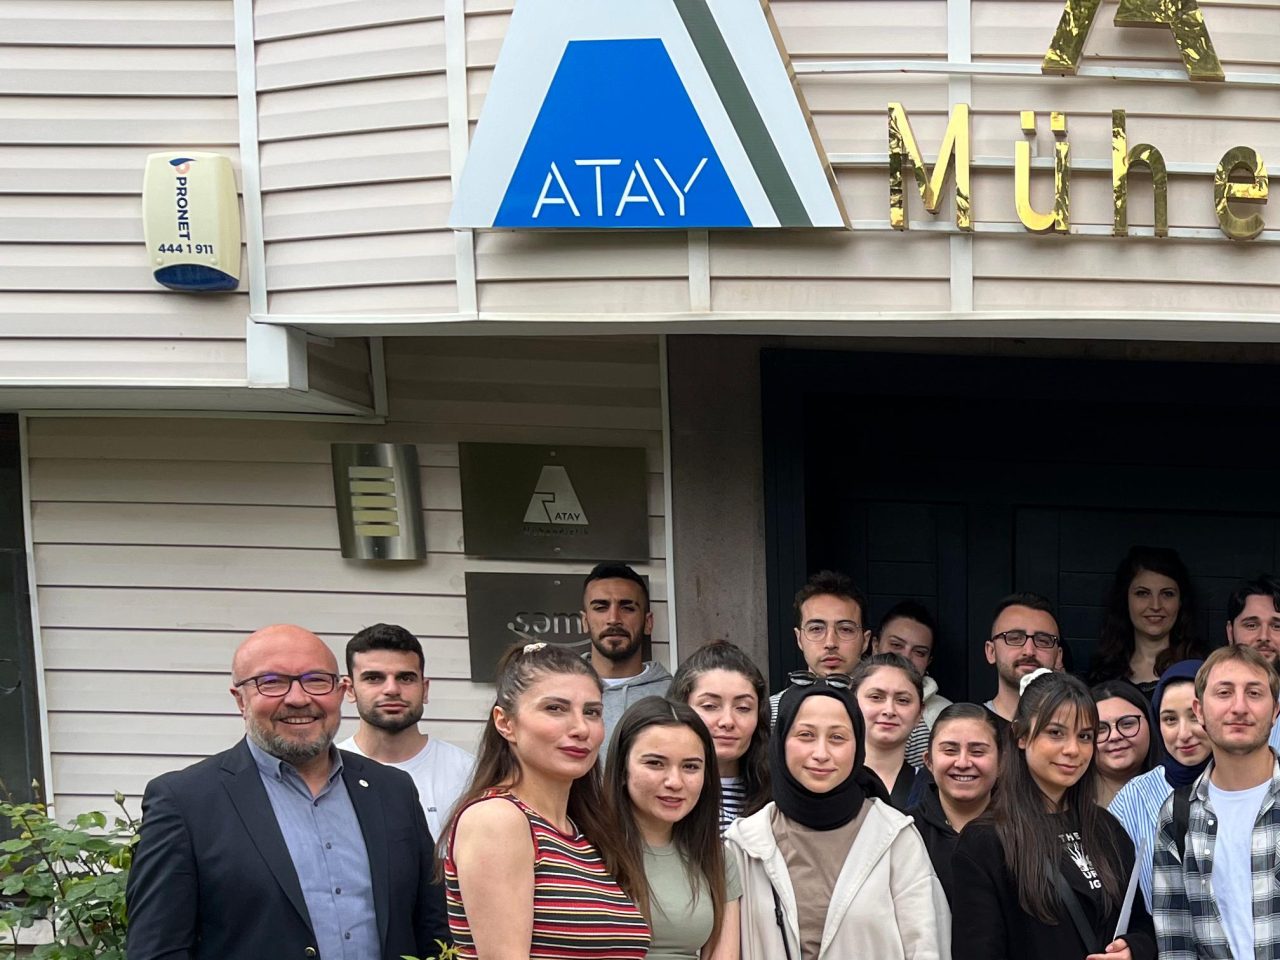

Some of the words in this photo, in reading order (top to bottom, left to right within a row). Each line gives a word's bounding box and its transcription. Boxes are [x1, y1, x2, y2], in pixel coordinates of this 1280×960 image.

[531, 157, 709, 218] ATAY
[176, 177, 190, 240] PRONET
[158, 244, 183, 253] 444
[195, 244, 213, 254] 911
[554, 512, 580, 521] ATAY
[1058, 832, 1081, 843] THE
